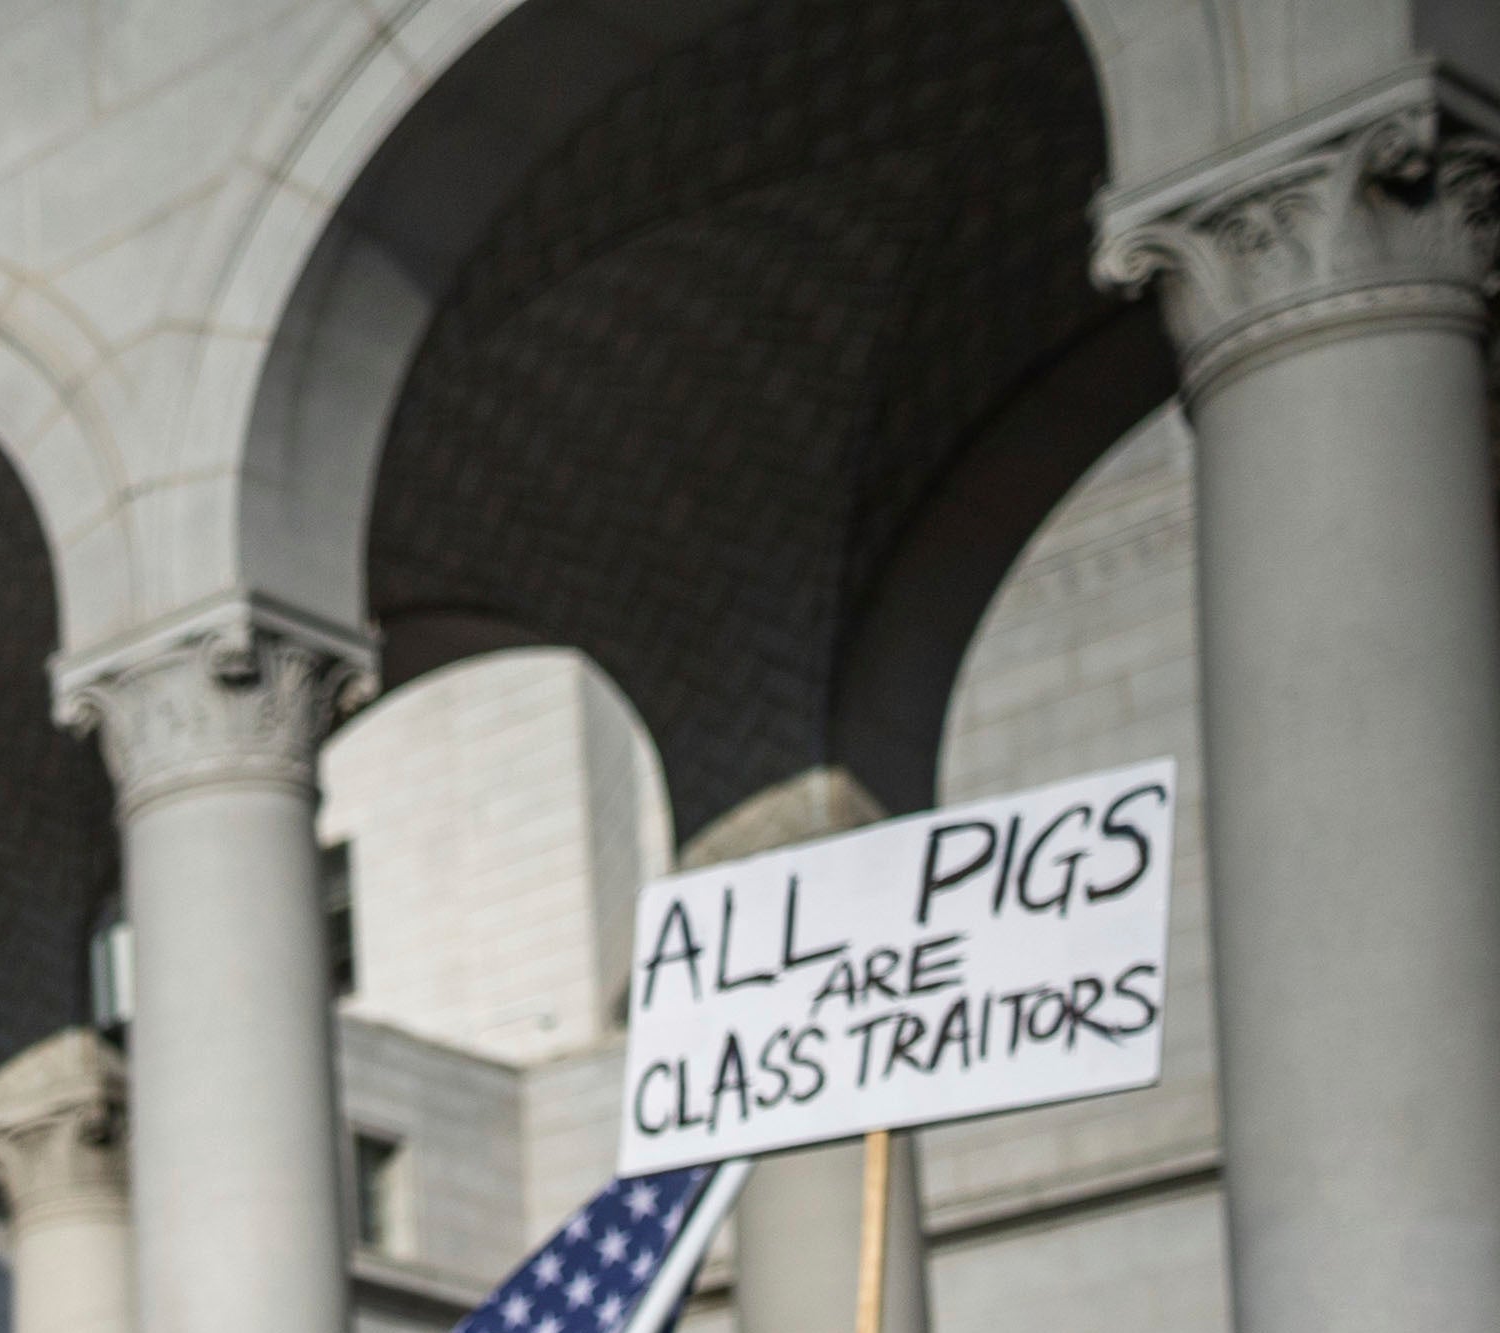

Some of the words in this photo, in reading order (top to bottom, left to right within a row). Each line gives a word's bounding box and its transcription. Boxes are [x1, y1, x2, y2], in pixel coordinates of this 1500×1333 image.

[642, 874, 851, 1013] ALL
[915, 781, 1168, 926] PIGS
[811, 932, 968, 1017] ARE
[633, 1023, 826, 1139] CLASS
[848, 963, 1160, 1090] TRAITORS
